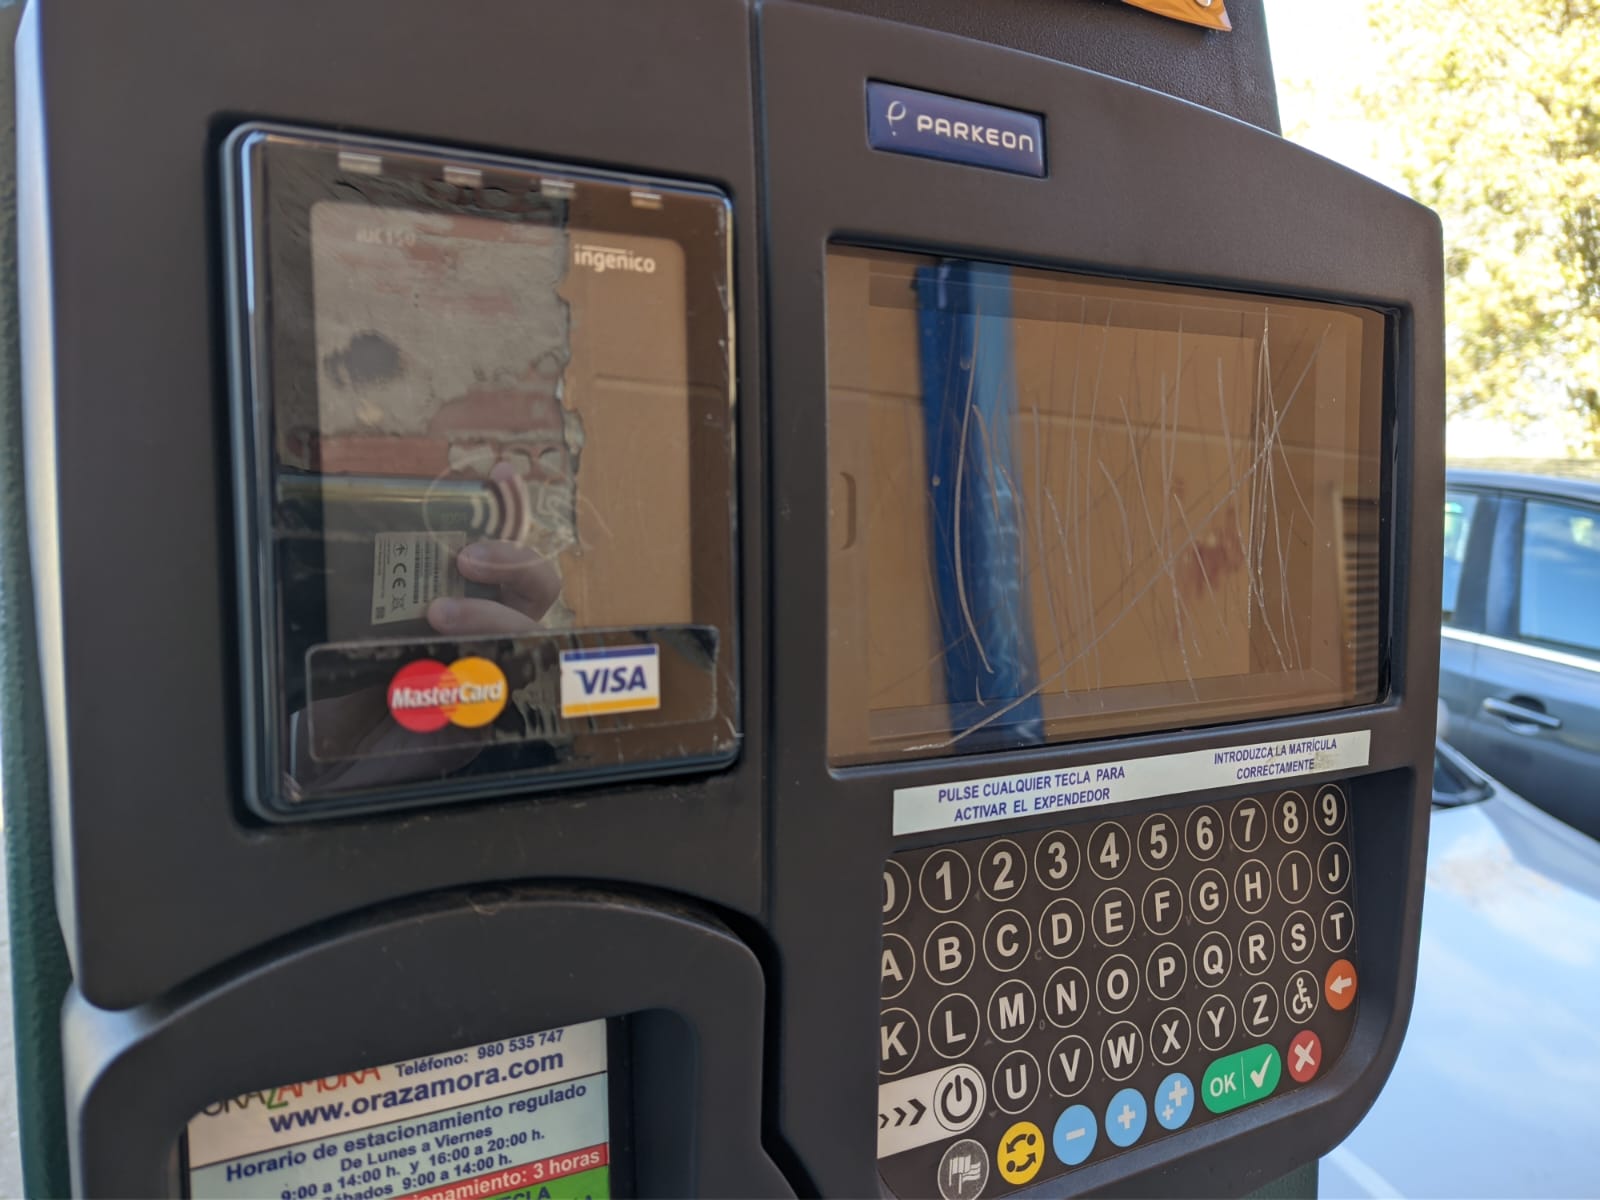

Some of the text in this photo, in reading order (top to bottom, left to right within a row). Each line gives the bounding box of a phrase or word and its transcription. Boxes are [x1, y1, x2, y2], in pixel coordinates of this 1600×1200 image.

[917, 115, 1034, 153] PARKEON
[573, 243, 656, 273] ingenico
[391, 681, 503, 709] MasterCard
[574, 665, 647, 695] VISA
[1214, 738, 1337, 765] INTRODUZCA LA MATRÍCULA
[1237, 758, 1315, 780] CORRECTAMENTE
[938, 766, 1125, 803] PULSE CUALQUIER TECLA PARA
[954, 788, 1110, 822] ACTIVAR EL EXPENDEDOR
[935, 861, 953, 901] 1
[992, 851, 1015, 891] 2
[1047, 841, 1068, 880] 3
[1099, 832, 1120, 869] 4
[1150, 823, 1168, 860] 5
[1196, 815, 1214, 851] 6
[1239, 807, 1256, 842] 7
[1282, 800, 1299, 834] 8
[1322, 794, 1338, 826] 9
[880, 854, 1340, 982] A B C D E F G H I J
[880, 912, 1345, 1061] K L M N O P Q R S T
[394, 1029, 564, 1078] Teléfono: 980 535 747
[1005, 993, 1270, 1100] U V W X Y Z
[270, 1052, 563, 1133] www.orazamora.com
[1210, 1072, 1237, 1097] OK
[226, 1085, 586, 1182] Horario de estacionamiento regulado
[340, 1126, 492, 1171] De Lunes a Viernes
[281, 1128, 545, 1200] 9:00 a 14:00 h. y 16:00 a 20:00 h.
[402, 1171, 436, 1190] 9:00
[440, 1170, 449, 1180] a
[454, 1155, 494, 1176] 14:00
[499, 1153, 513, 1166] h.
[533, 1162, 544, 1180] 3
[549, 1150, 601, 1176] horas
